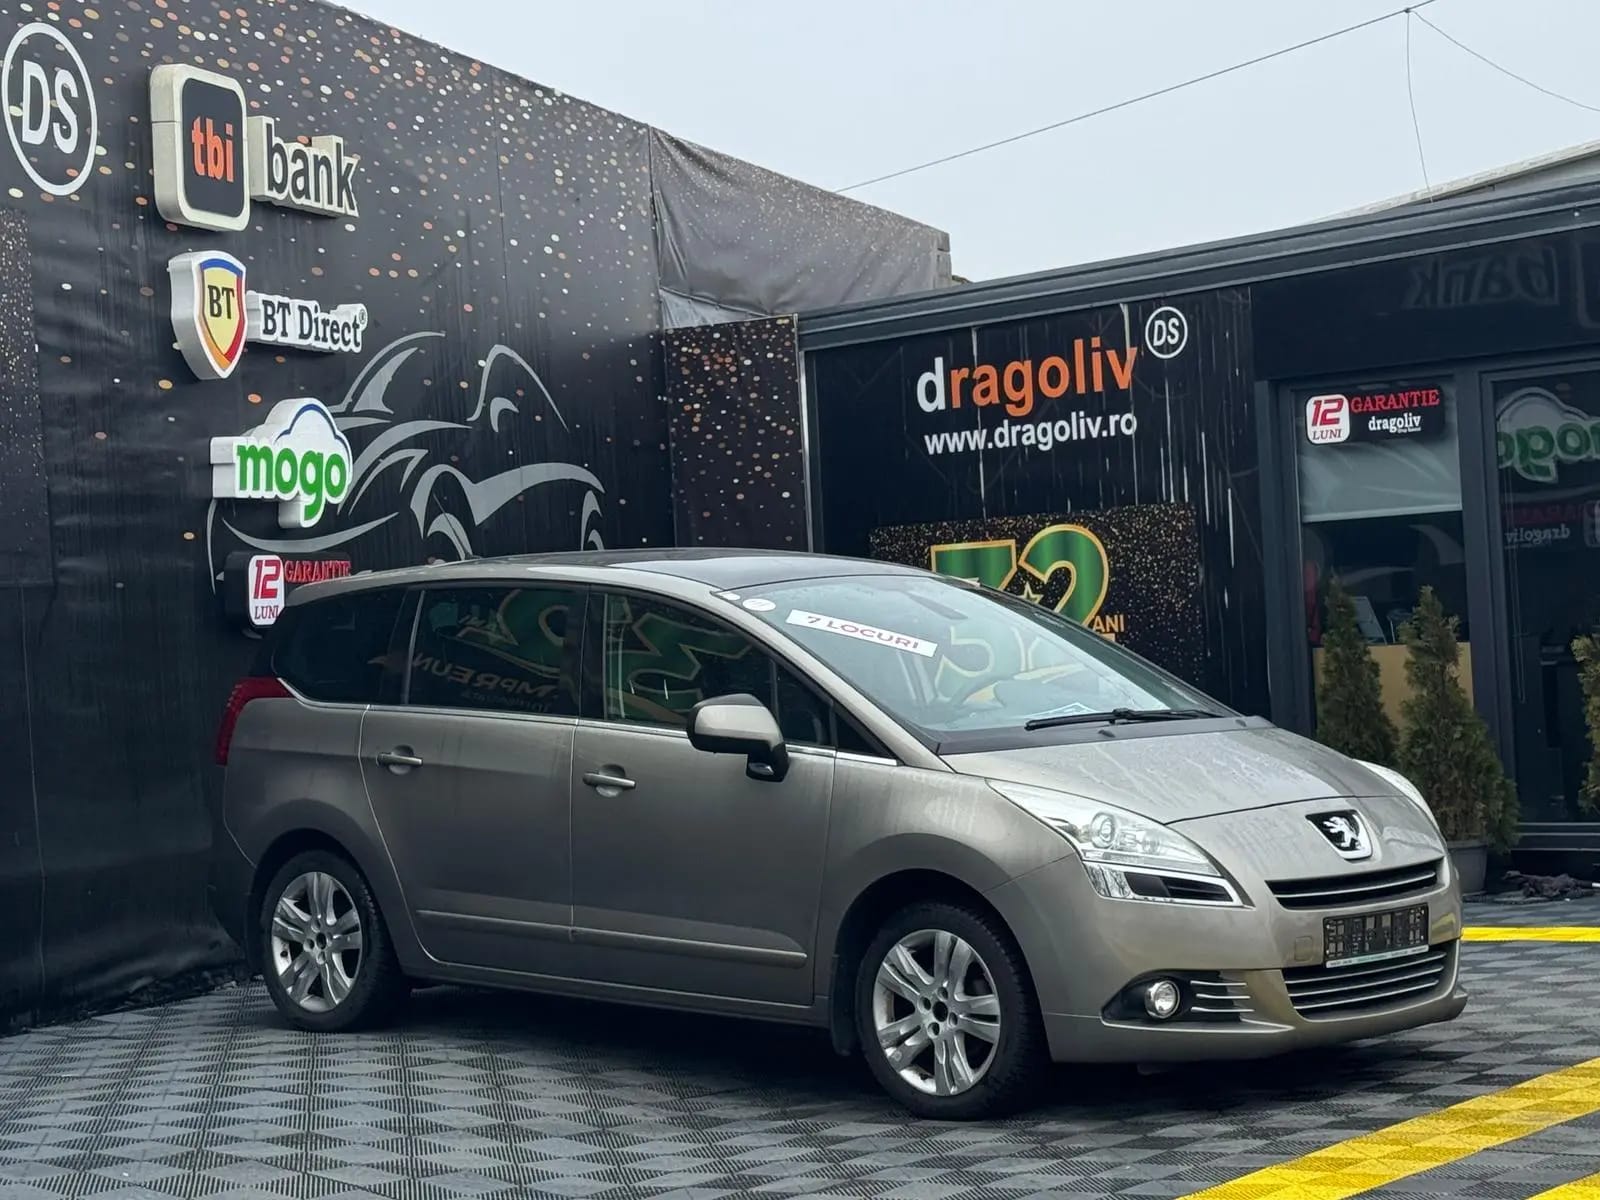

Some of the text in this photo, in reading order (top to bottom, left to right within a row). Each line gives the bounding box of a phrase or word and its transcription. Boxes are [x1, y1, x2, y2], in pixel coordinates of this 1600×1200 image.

[22, 60, 79, 154] DS
[191, 116, 357, 211] tbi bank
[207, 284, 235, 320] BT
[262, 300, 291, 337] BT
[1153, 317, 1180, 347] DS
[916, 336, 1138, 417] dragoliv
[1311, 398, 1344, 427] 12
[1350, 389, 1440, 414] GARANTIE
[924, 410, 1138, 456] www.dragoliv.ro
[1312, 428, 1342, 440] LUNI
[1368, 412, 1421, 433] dragoliv
[236, 443, 347, 521] mogo
[254, 560, 281, 599] 12
[807, 615, 919, 649] 7 LOCURI
[1092, 614, 1125, 633] ANI
